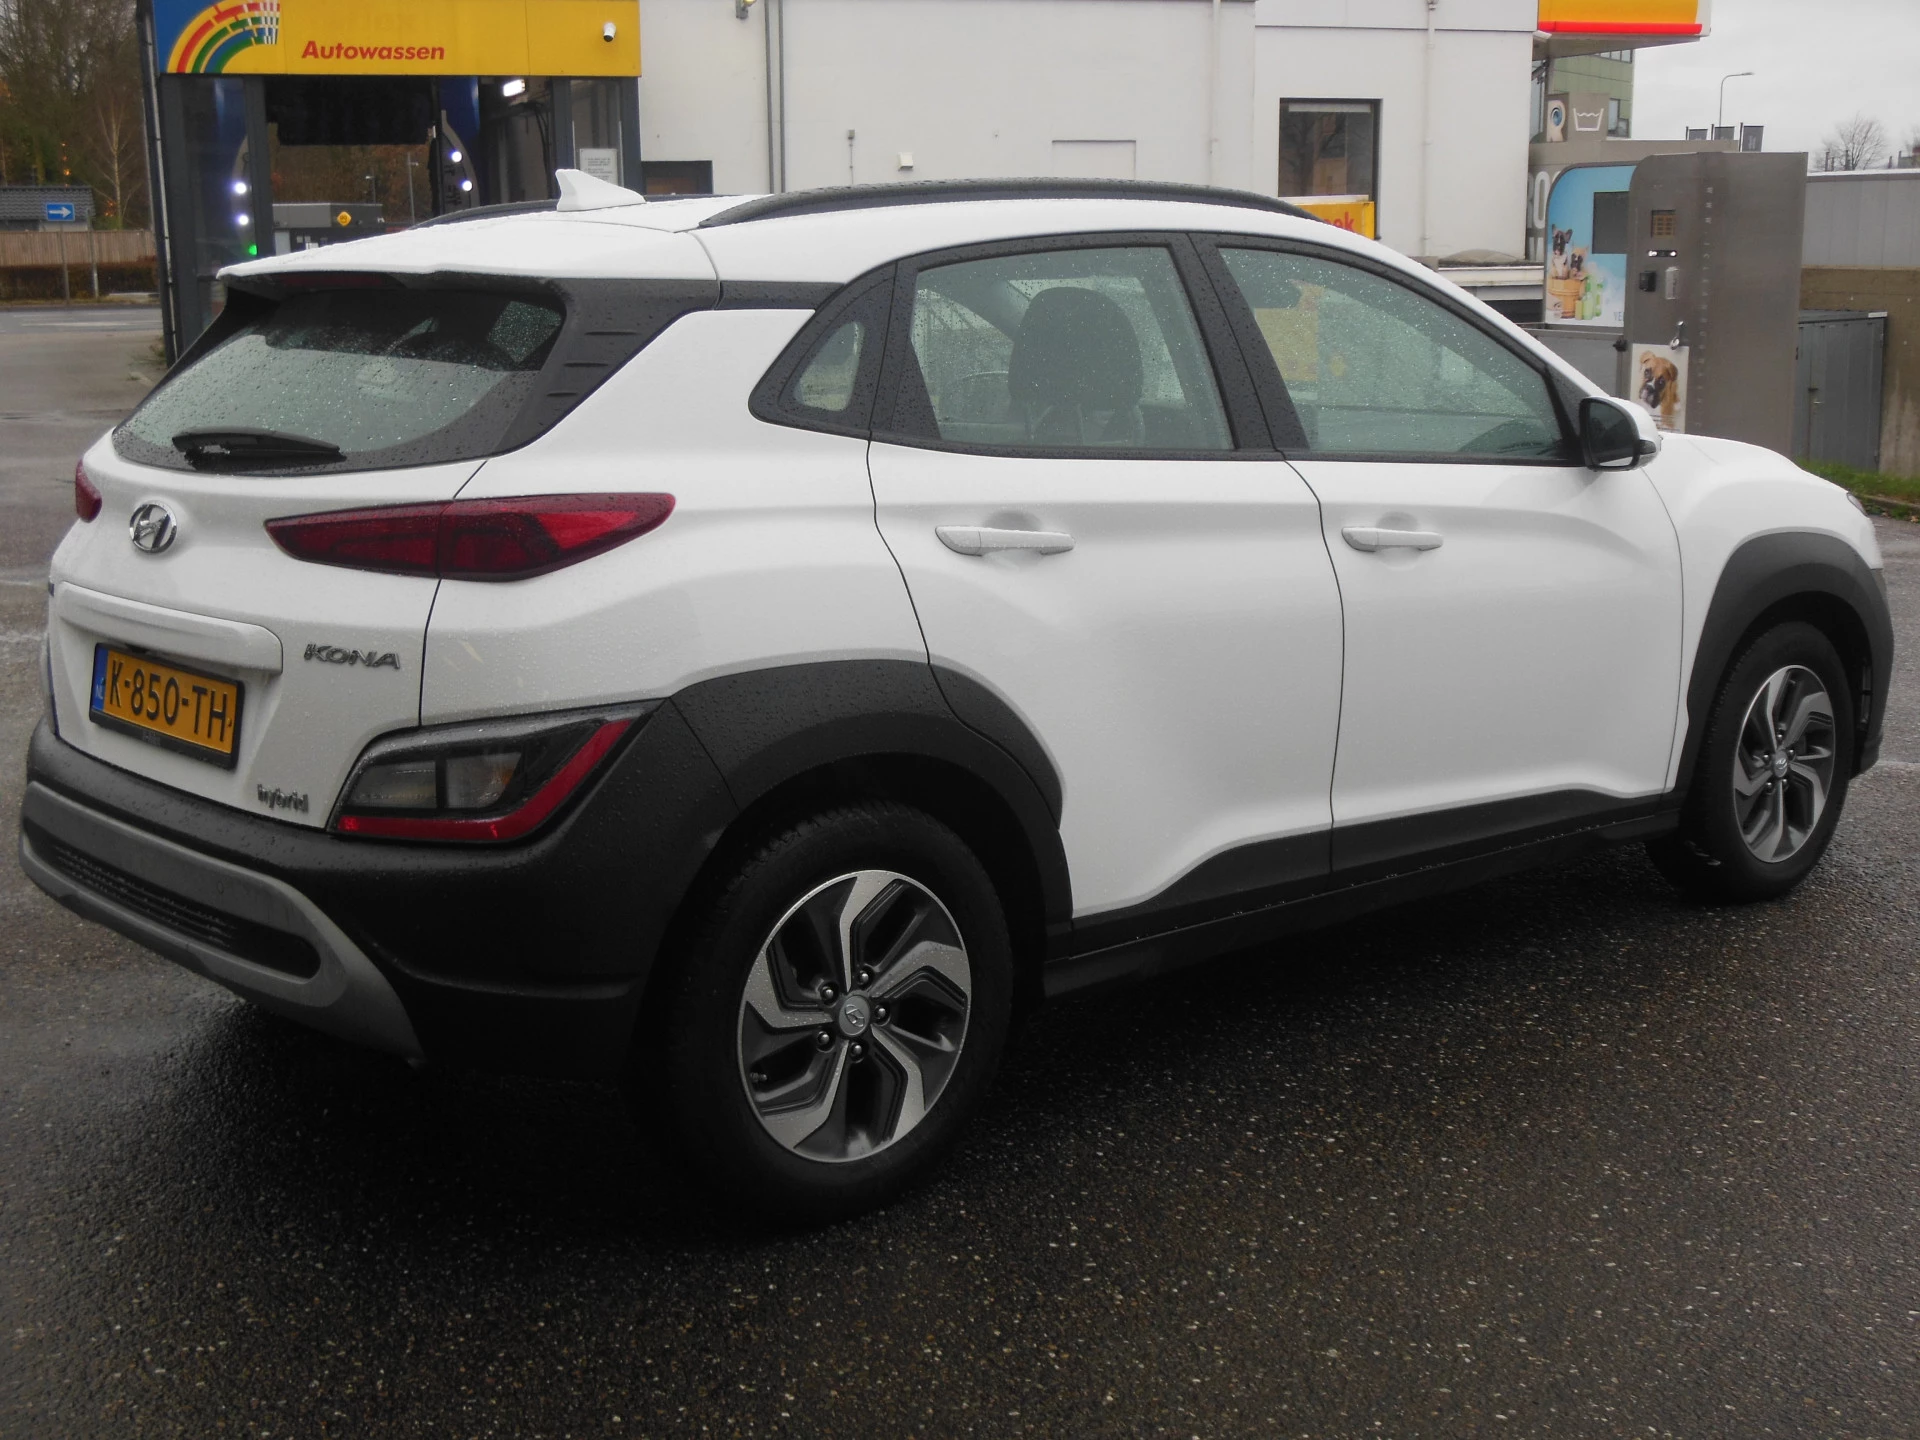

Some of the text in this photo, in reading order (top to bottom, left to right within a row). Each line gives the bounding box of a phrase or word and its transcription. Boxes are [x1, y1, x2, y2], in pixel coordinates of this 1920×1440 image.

[301, 40, 446, 60] Autowassen
[303, 643, 401, 670] KONA
[110, 659, 228, 742] K-850-TH
[257, 783, 309, 814] hybrid
